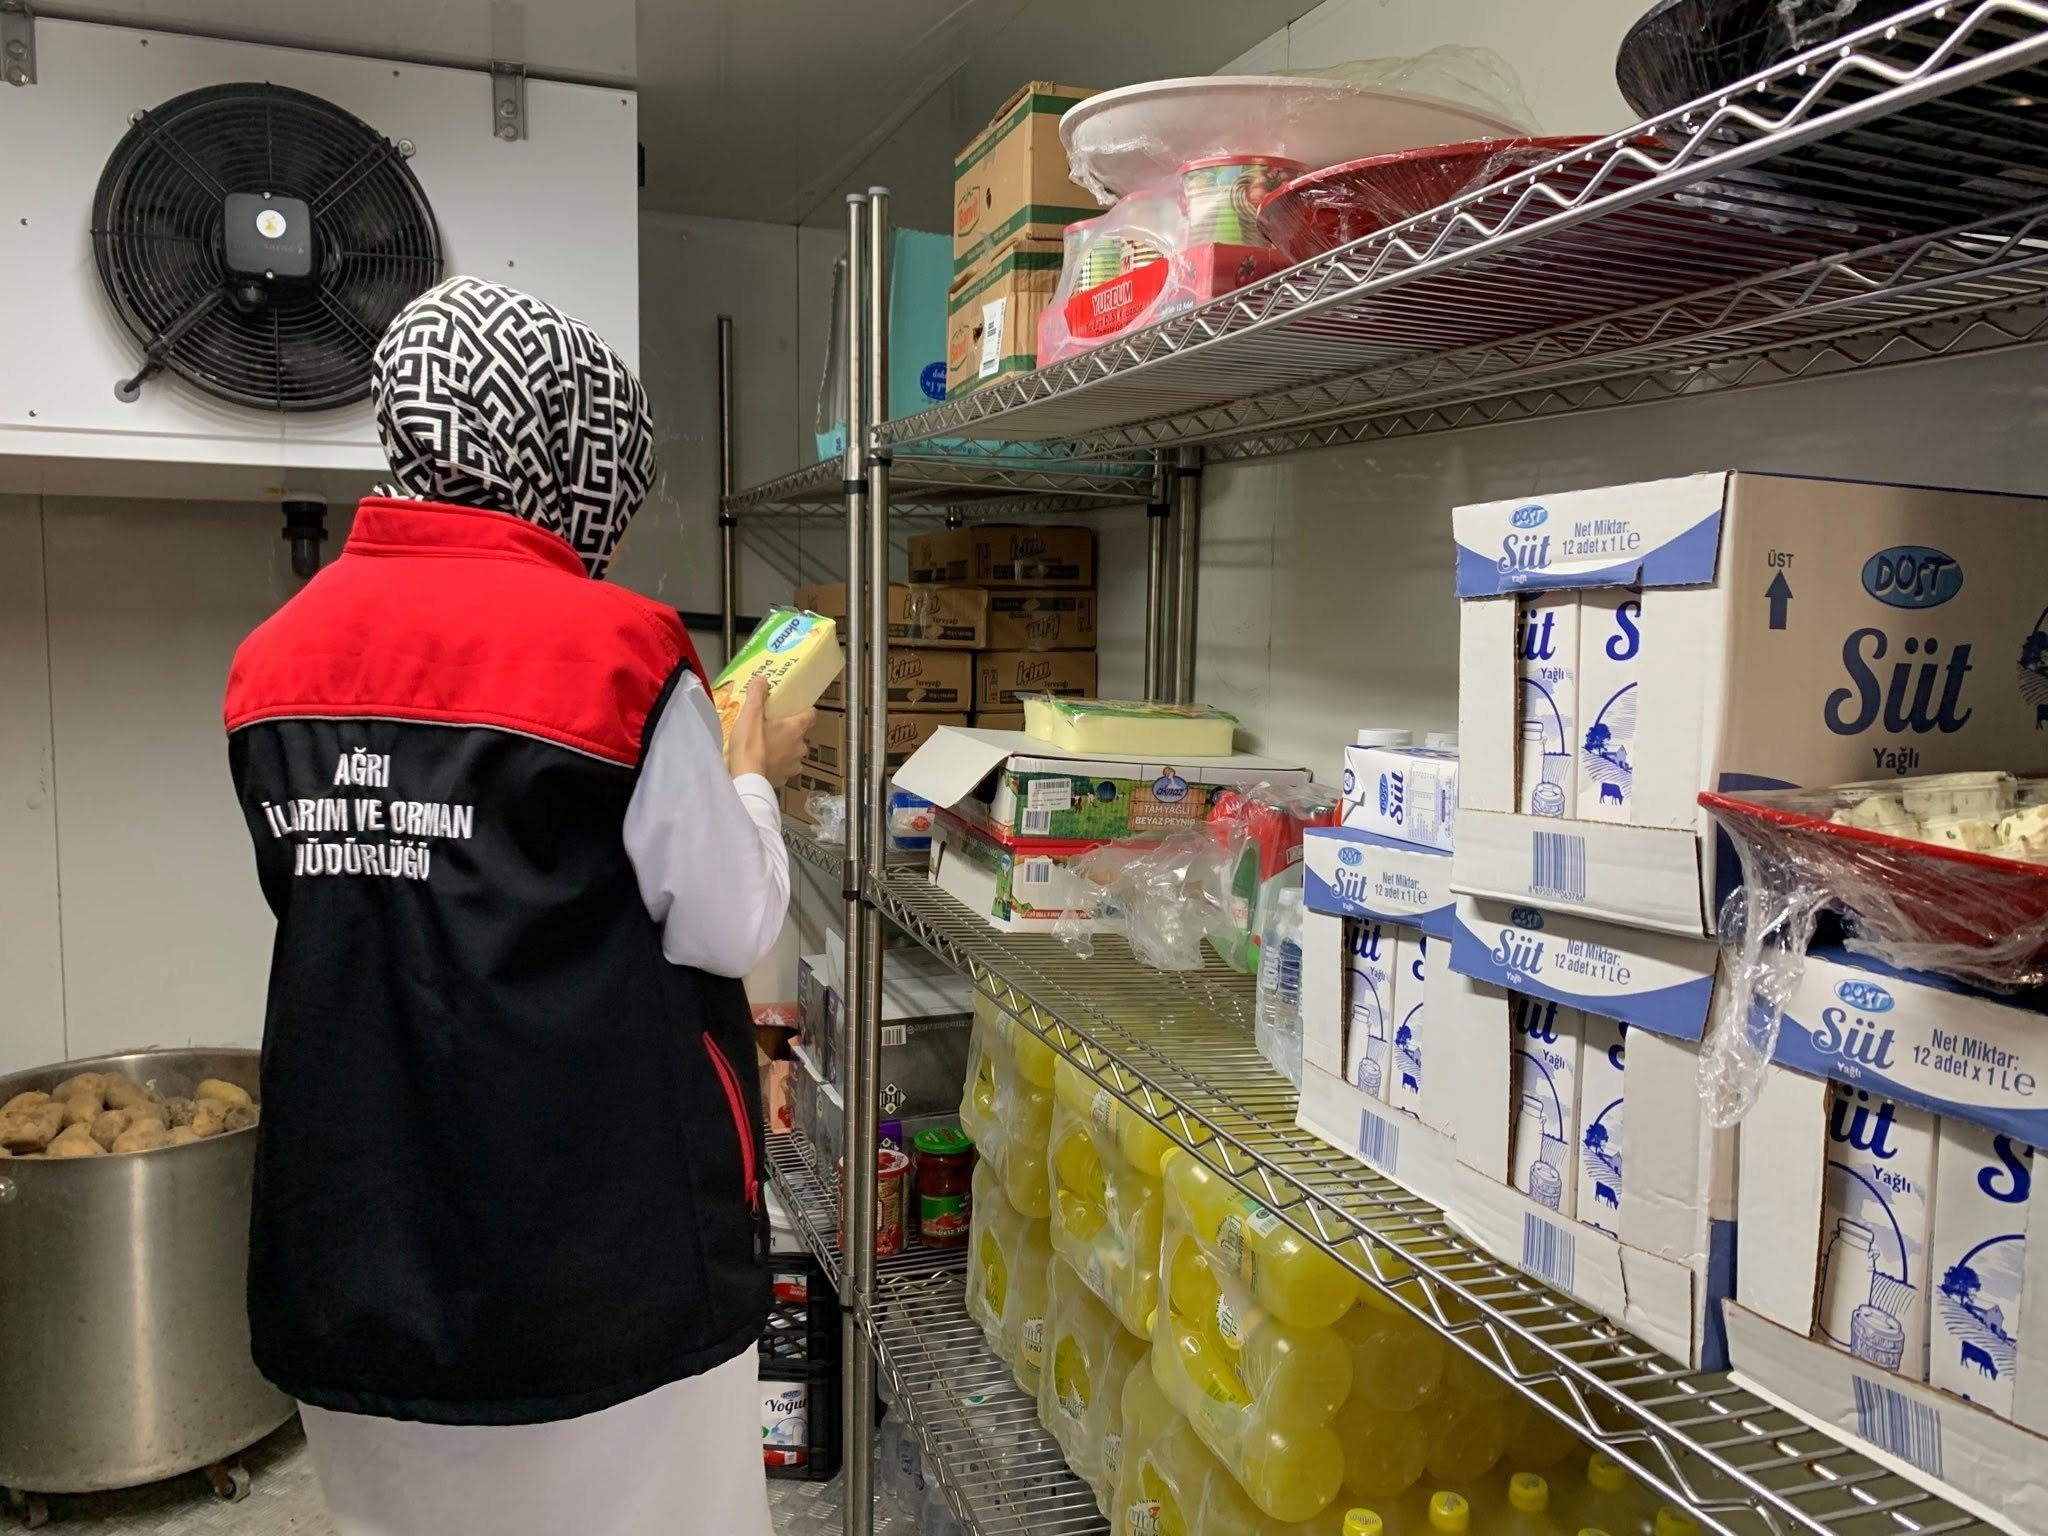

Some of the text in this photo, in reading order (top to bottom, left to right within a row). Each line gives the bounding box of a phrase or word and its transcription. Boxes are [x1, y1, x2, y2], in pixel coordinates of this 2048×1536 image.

[1574, 519, 1630, 537] Net Miktar:
[1499, 534, 1552, 573] Süt
[1562, 541, 1574, 555] 12
[1577, 537, 1599, 554] adet
[1601, 541, 1607, 552] x
[1768, 549, 1795, 569] ÜST
[1874, 555, 1957, 600] DOST
[1541, 668, 1565, 682] Yağlı
[1823, 627, 1973, 736] Süt
[333, 746, 391, 788] AĞRI
[1873, 746, 1920, 776] Yağlı
[1144, 803, 1190, 816] TAM YAĞLI
[1390, 769, 1404, 826] Süt
[354, 799, 385, 831] VE
[389, 801, 474, 840] ORMAN
[1135, 816, 1163, 826] BEYAZ
[1331, 867, 1368, 903] Süt
[1375, 884, 1383, 896] 12
[1384, 887, 1400, 899] adet
[1401, 891, 1405, 900] x
[1382, 871, 1420, 890] Net Miktar:
[1491, 928, 1544, 974] Süt
[1554, 953, 1565, 969] 12
[1568, 957, 1589, 976] adet
[1591, 966, 1597, 978] x
[1567, 939, 1621, 966] Net Miktar:
[1811, 1006, 1896, 1070] Süt
[1932, 1028, 2020, 1071] Net Miktar:
[1543, 1049, 1565, 1070] Yağlı
[1837, 1060, 1862, 1080] Yağlı
[1913, 1045, 1931, 1066] 12
[1935, 1053, 1968, 1078] adet
[1972, 1065, 1981, 1082] x
[1872, 1164, 1911, 1194] Yağlı
